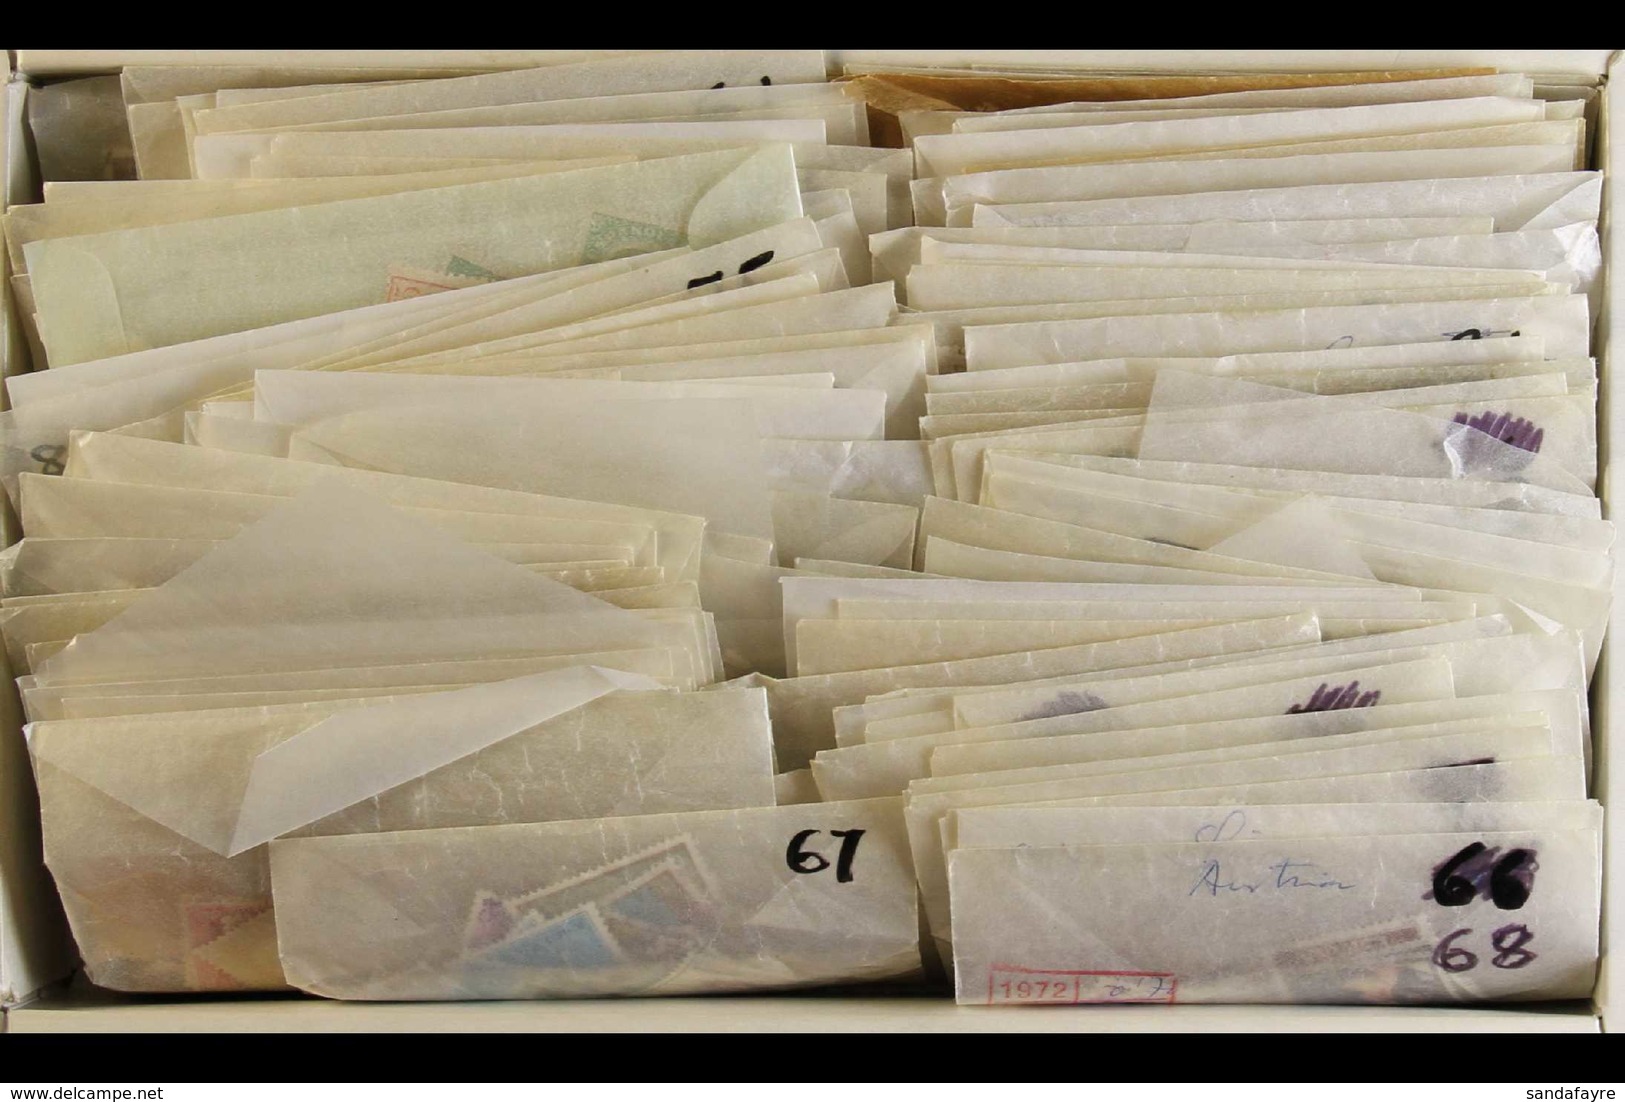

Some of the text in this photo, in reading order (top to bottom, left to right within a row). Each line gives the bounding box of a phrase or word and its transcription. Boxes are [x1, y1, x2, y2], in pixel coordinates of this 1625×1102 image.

[786, 829, 866, 883] 67
[1189, 859, 1356, 896] Austria
[1432, 841, 1533, 911] 66
[1431, 923, 1538, 973] 68
[1000, 980, 1068, 999] 1972
